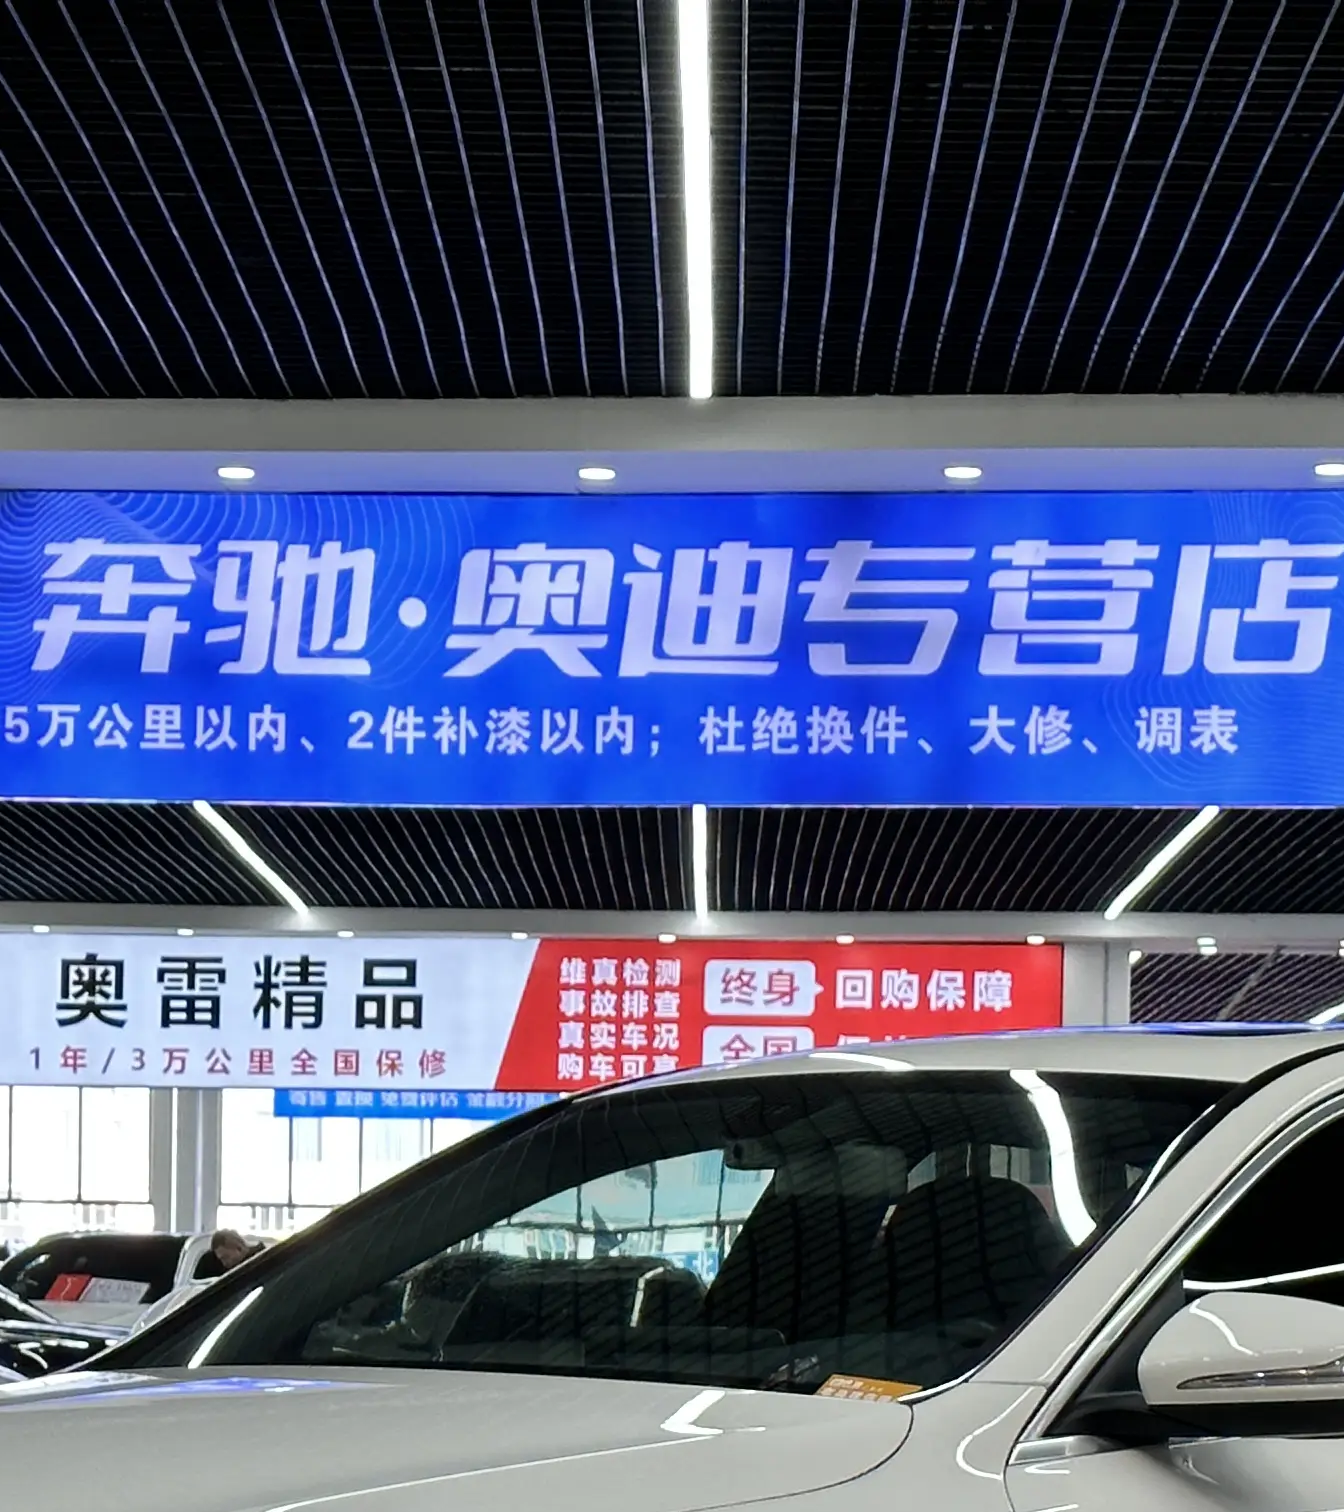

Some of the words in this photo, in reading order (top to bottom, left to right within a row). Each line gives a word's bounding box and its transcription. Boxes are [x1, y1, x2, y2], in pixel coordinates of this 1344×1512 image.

[559, 957, 681, 987] 维真检测
[721, 968, 800, 1007] 终身
[56, 953, 423, 1029] 奥雷精品
[559, 989, 681, 1019] 事故排查
[835, 968, 1012, 1012] 回购保障
[558, 1021, 680, 1051] 真实车况
